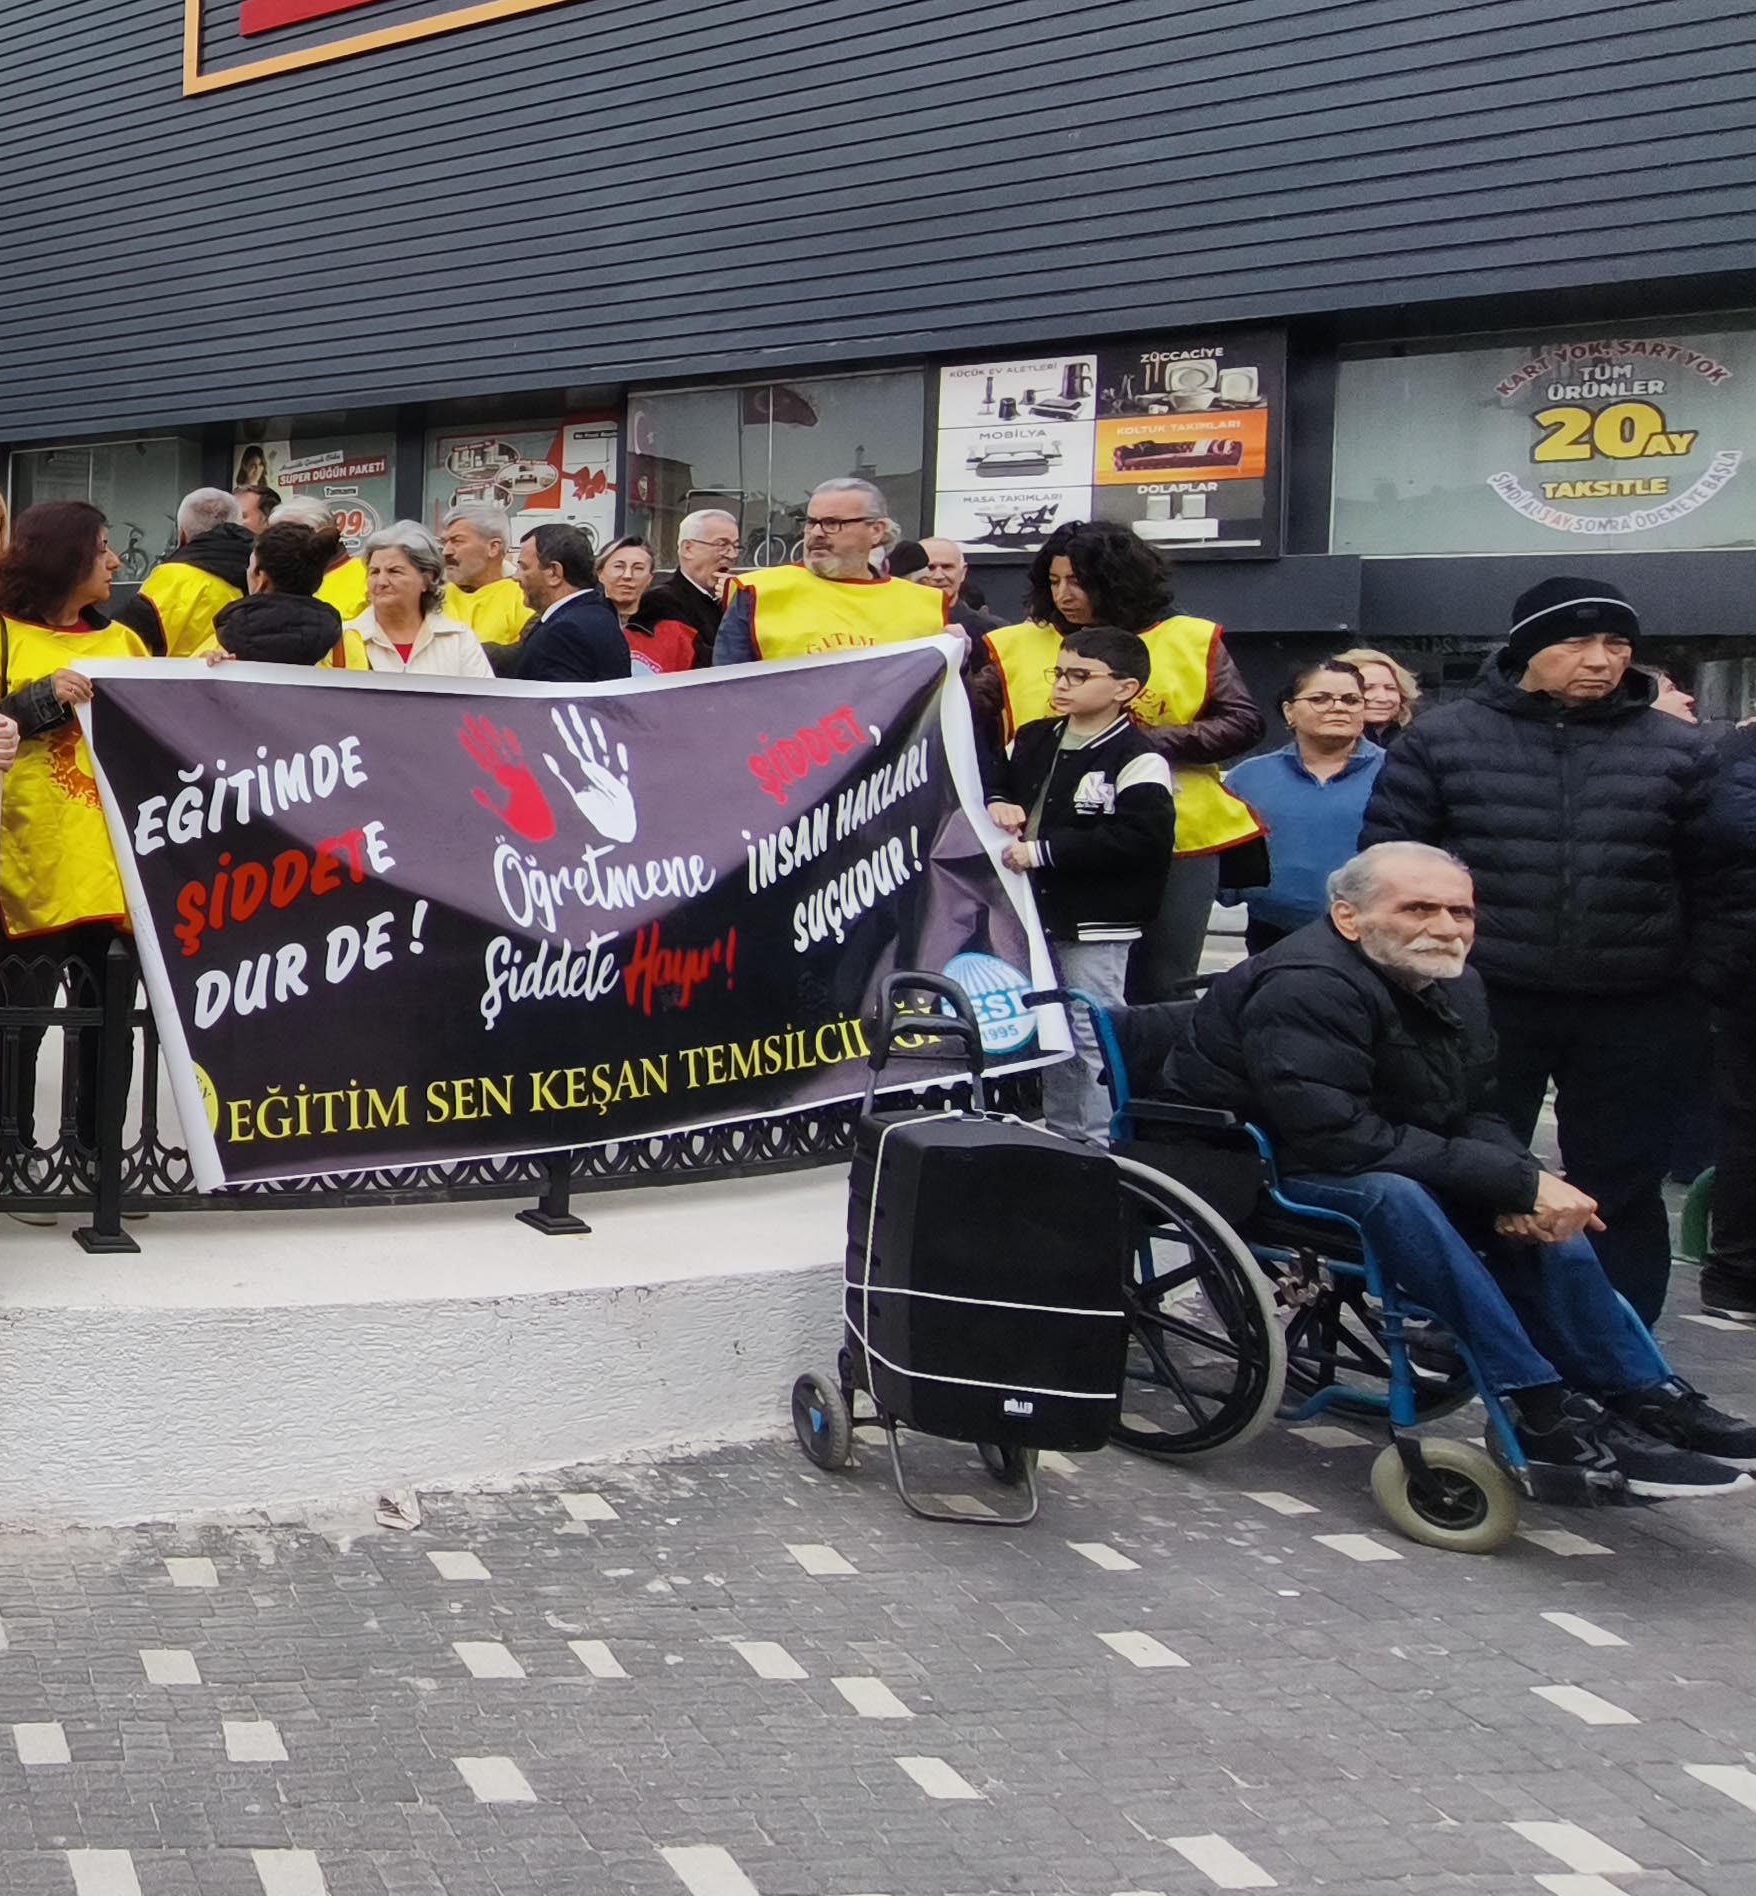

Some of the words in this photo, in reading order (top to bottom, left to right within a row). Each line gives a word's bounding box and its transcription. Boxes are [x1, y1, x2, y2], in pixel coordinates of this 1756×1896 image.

[949, 368, 986, 378] KÜÇÜK
[988, 367, 1003, 375] EV
[1006, 362, 1058, 374] ALETLERİ
[1496, 358, 1550, 396] KART
[1684, 352, 1728, 382] YOK
[1580, 363, 1633, 381] TÜM
[1547, 379, 1666, 401] ÜRÜNLER
[979, 429, 1047, 440] MOBİLYA
[1116, 424, 1166, 436] KOLTUK
[1532, 401, 1664, 462] 20
[1642, 431, 1697, 456] AY
[348, 459, 385, 476] PAKETİ
[963, 495, 996, 504] MASA
[999, 493, 1063, 503] TAKIMLARI
[1137, 481, 1219, 495] DOLAPLAR
[1573, 518, 1632, 532] SONRA
[133, 735, 368, 856] EĞİTİMDE
[741, 803, 829, 896] İNSAN
[835, 737, 928, 842] HAKLARI
[173, 819, 397, 957] ŞİDDETE
[492, 834, 717, 933] Öğretmene
[193, 943, 309, 1030] DUR
[479, 929, 621, 1031] Şiddete
[982, 1024, 1019, 1041] 1995
[226, 1078, 410, 1143] EĞİTİM
[425, 1075, 514, 1124] SEN
[529, 1053, 669, 1116] KEŞAN
